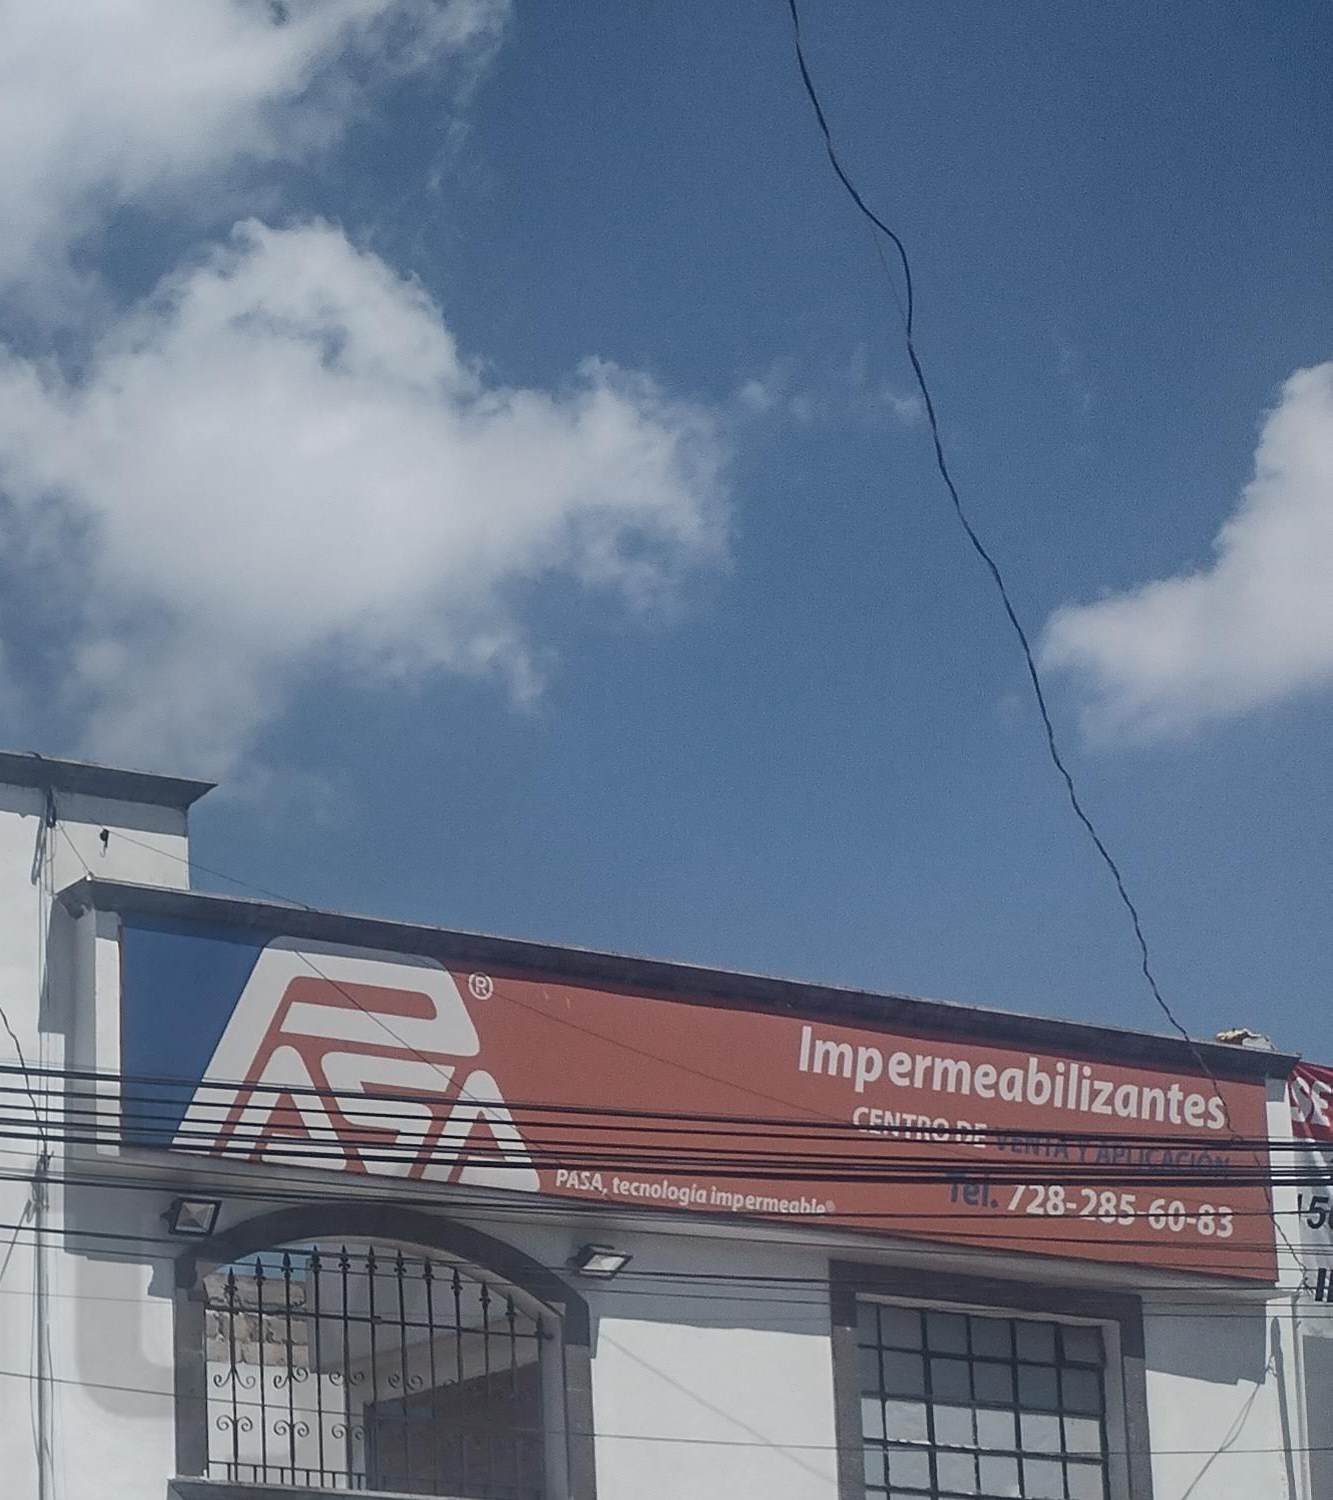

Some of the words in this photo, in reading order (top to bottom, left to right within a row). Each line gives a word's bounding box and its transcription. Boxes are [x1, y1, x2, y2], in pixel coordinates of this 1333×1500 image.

[798, 1026, 1225, 1130] Impermeabilizantes
[852, 1106, 950, 1144] CENTRO
[955, 1119, 987, 1149] DE
[995, 1126, 1069, 1163] VENTA
[555, 1168, 608, 1194] PASA,
[612, 1176, 707, 1206] tecnología
[945, 1171, 998, 1209] Tel.
[1006, 1184, 1234, 1238] 728-285-60-83
